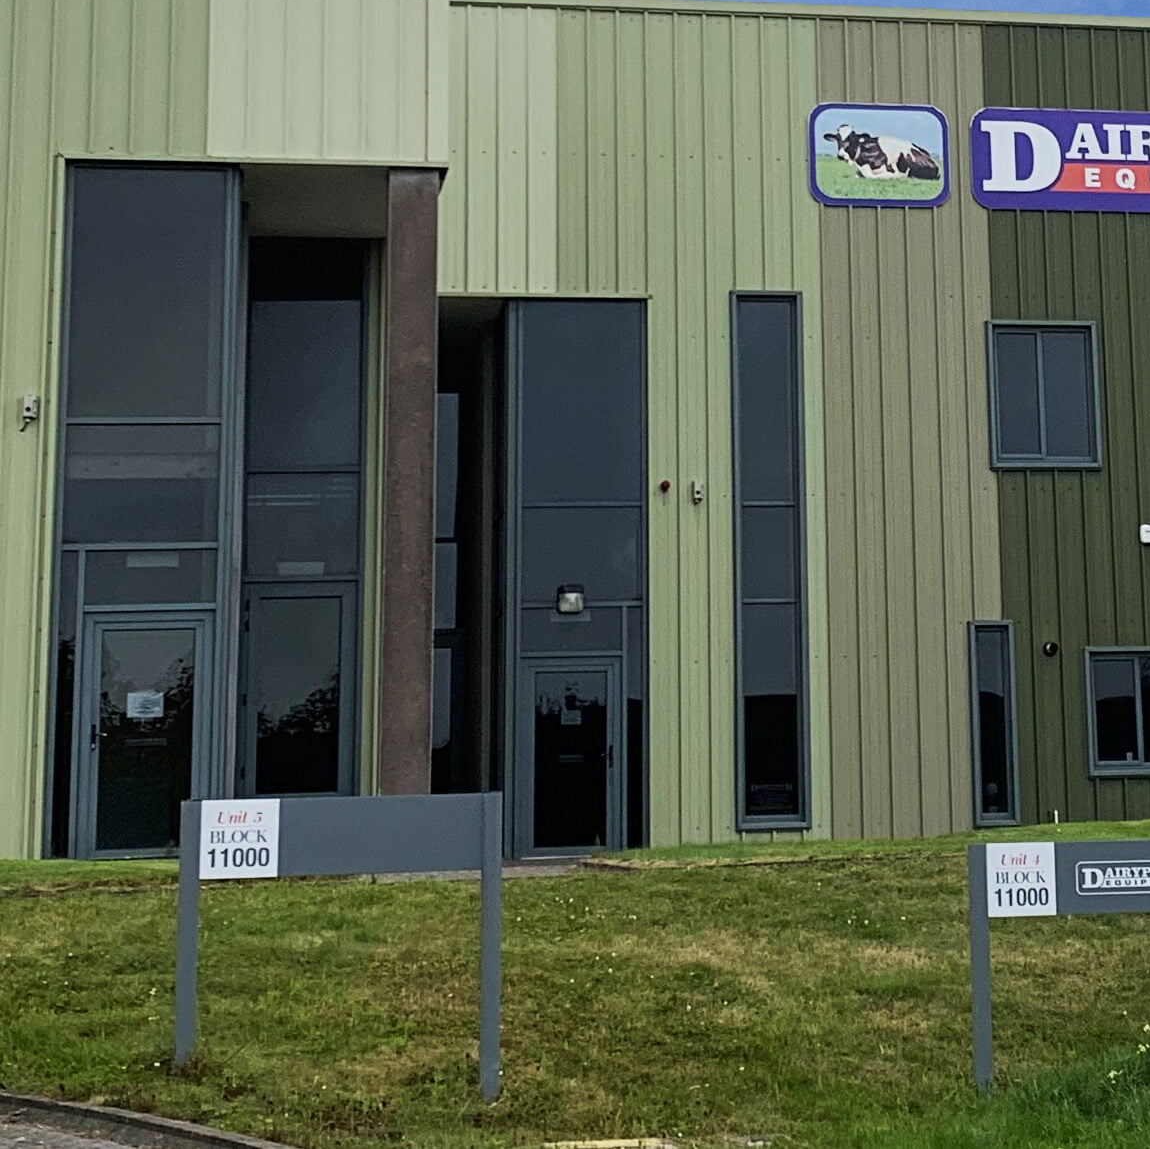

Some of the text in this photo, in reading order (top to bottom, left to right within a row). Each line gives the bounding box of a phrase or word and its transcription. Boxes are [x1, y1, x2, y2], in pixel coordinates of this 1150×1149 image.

[217, 810, 264, 824] Unit 5
[210, 829, 267, 844] BLOCK
[207, 847, 270, 868] 11000
[1000, 853, 1027, 866] Unit
[995, 870, 1046, 884] BLOCK
[994, 887, 1049, 907] 11000
